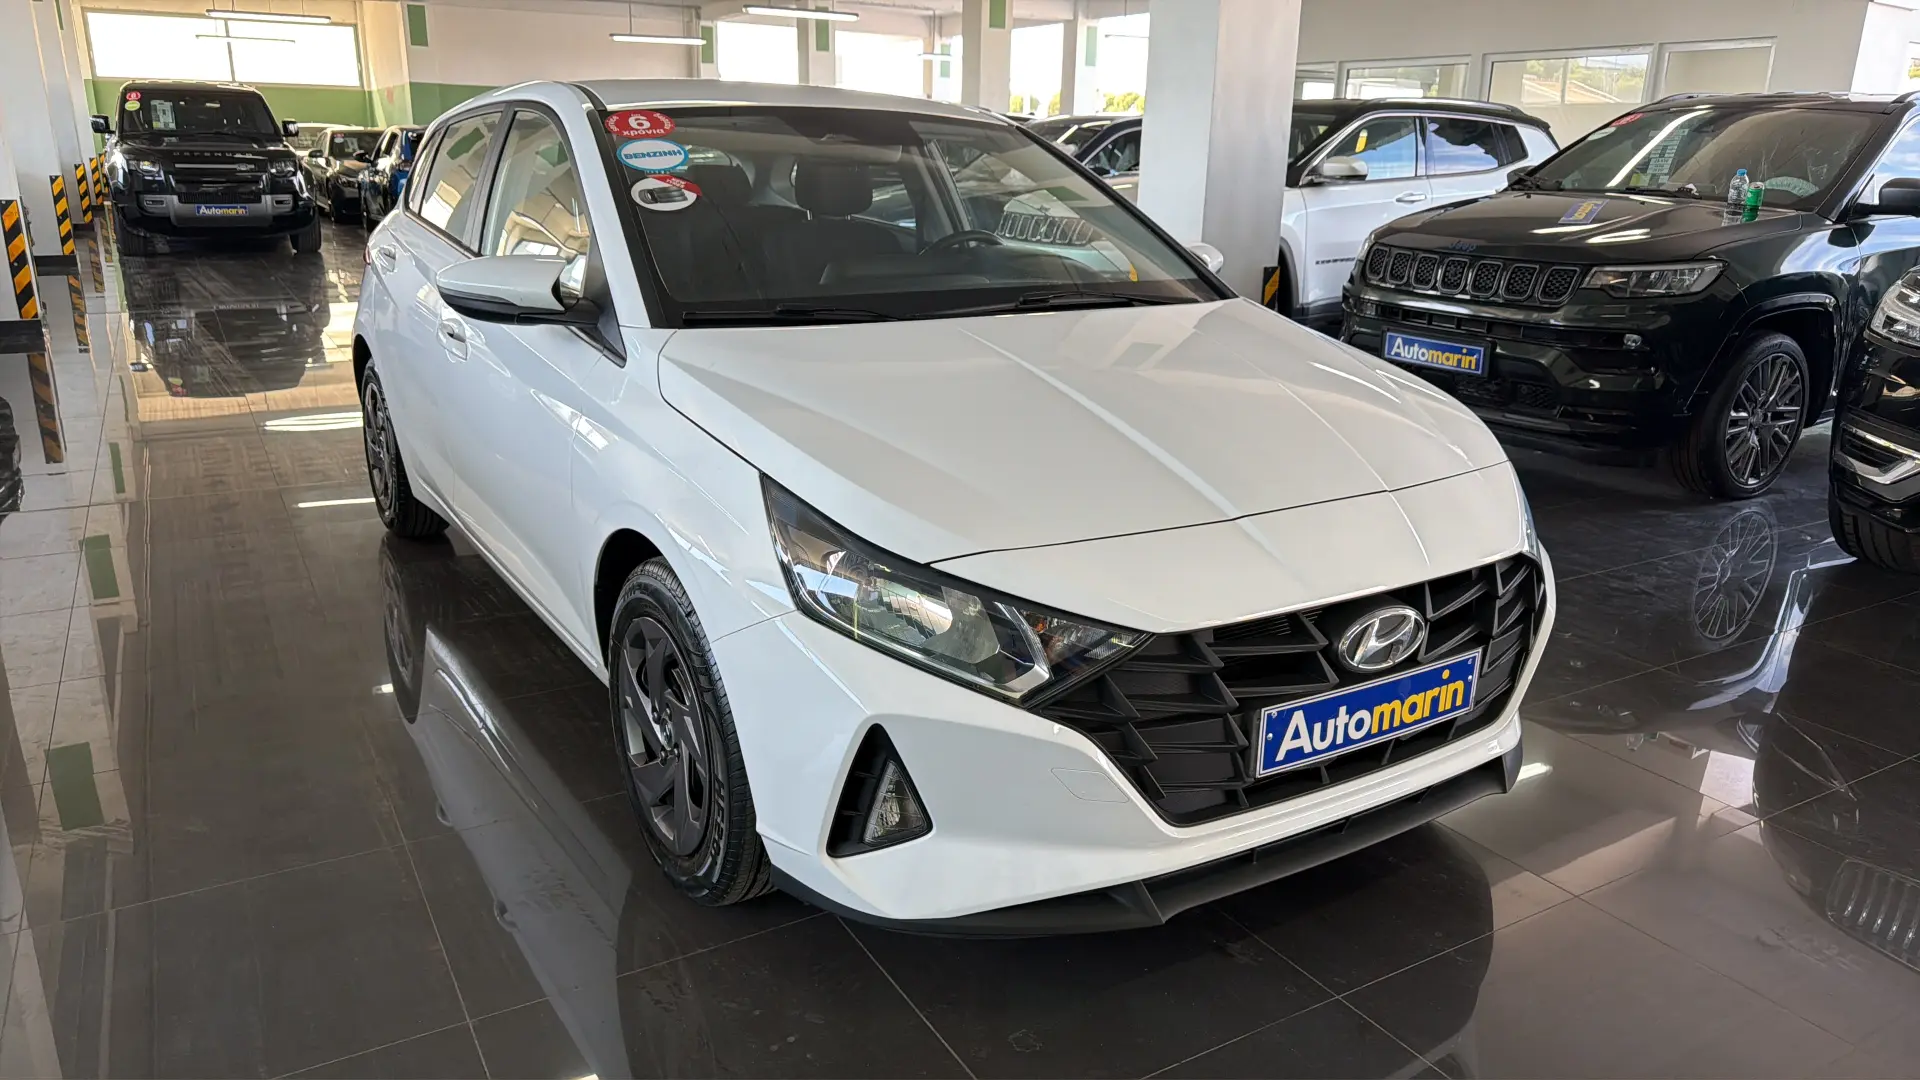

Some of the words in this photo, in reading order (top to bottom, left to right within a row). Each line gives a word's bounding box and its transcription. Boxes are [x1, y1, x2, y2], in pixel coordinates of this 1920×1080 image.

[628, 115, 651, 130] 6
[621, 128, 665, 137] χρόνια
[199, 204, 246, 216] Automarin
[1390, 337, 1477, 370] Automarin
[1274, 669, 1465, 762] Automarin
